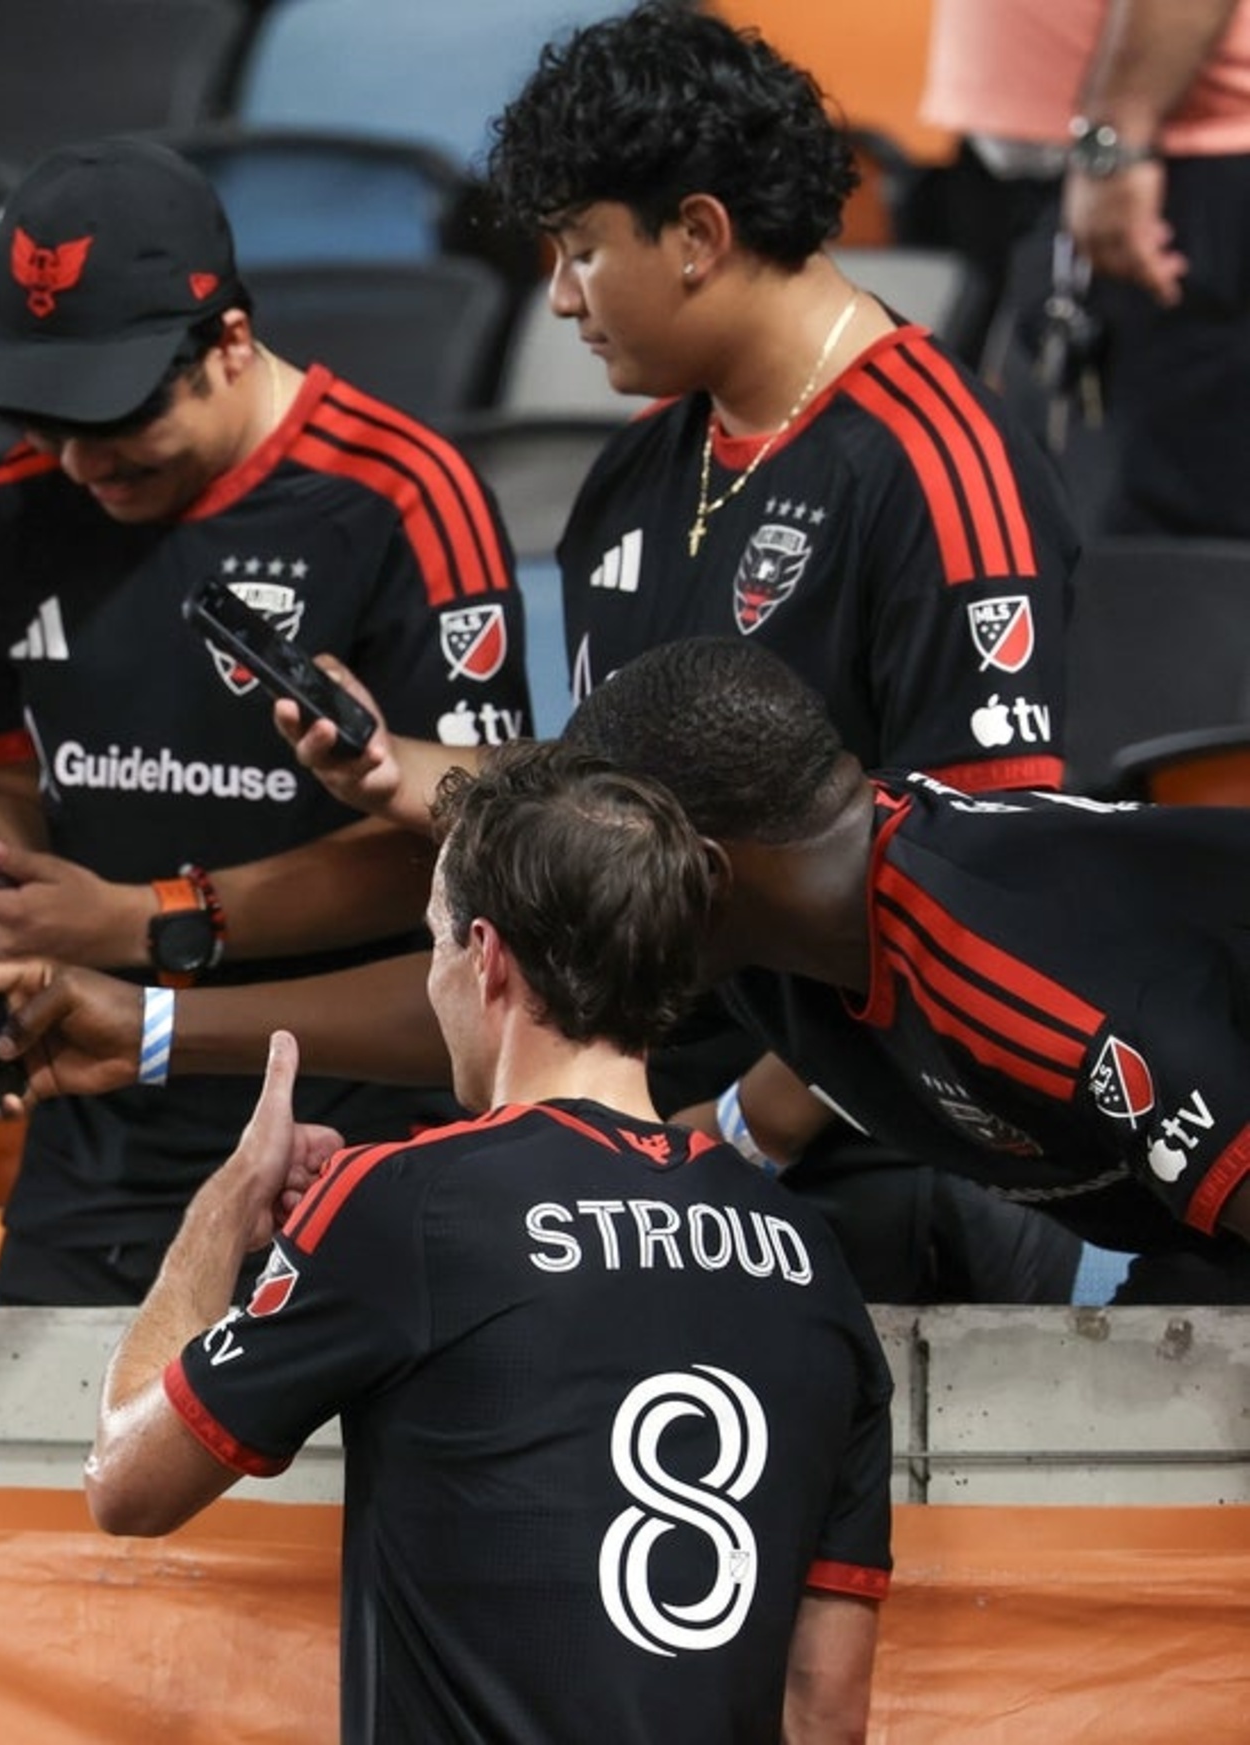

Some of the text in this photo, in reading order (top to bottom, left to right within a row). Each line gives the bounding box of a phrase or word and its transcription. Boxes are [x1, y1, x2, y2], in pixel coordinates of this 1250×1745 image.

[975, 604, 1012, 623] MLS
[478, 703, 524, 746] tv
[1012, 696, 1051, 743] tv
[54, 740, 298, 802] Guidehouse
[1161, 1089, 1215, 1150] tv
[524, 1198, 813, 1286] STROUD
[598, 1363, 769, 1658] 8
